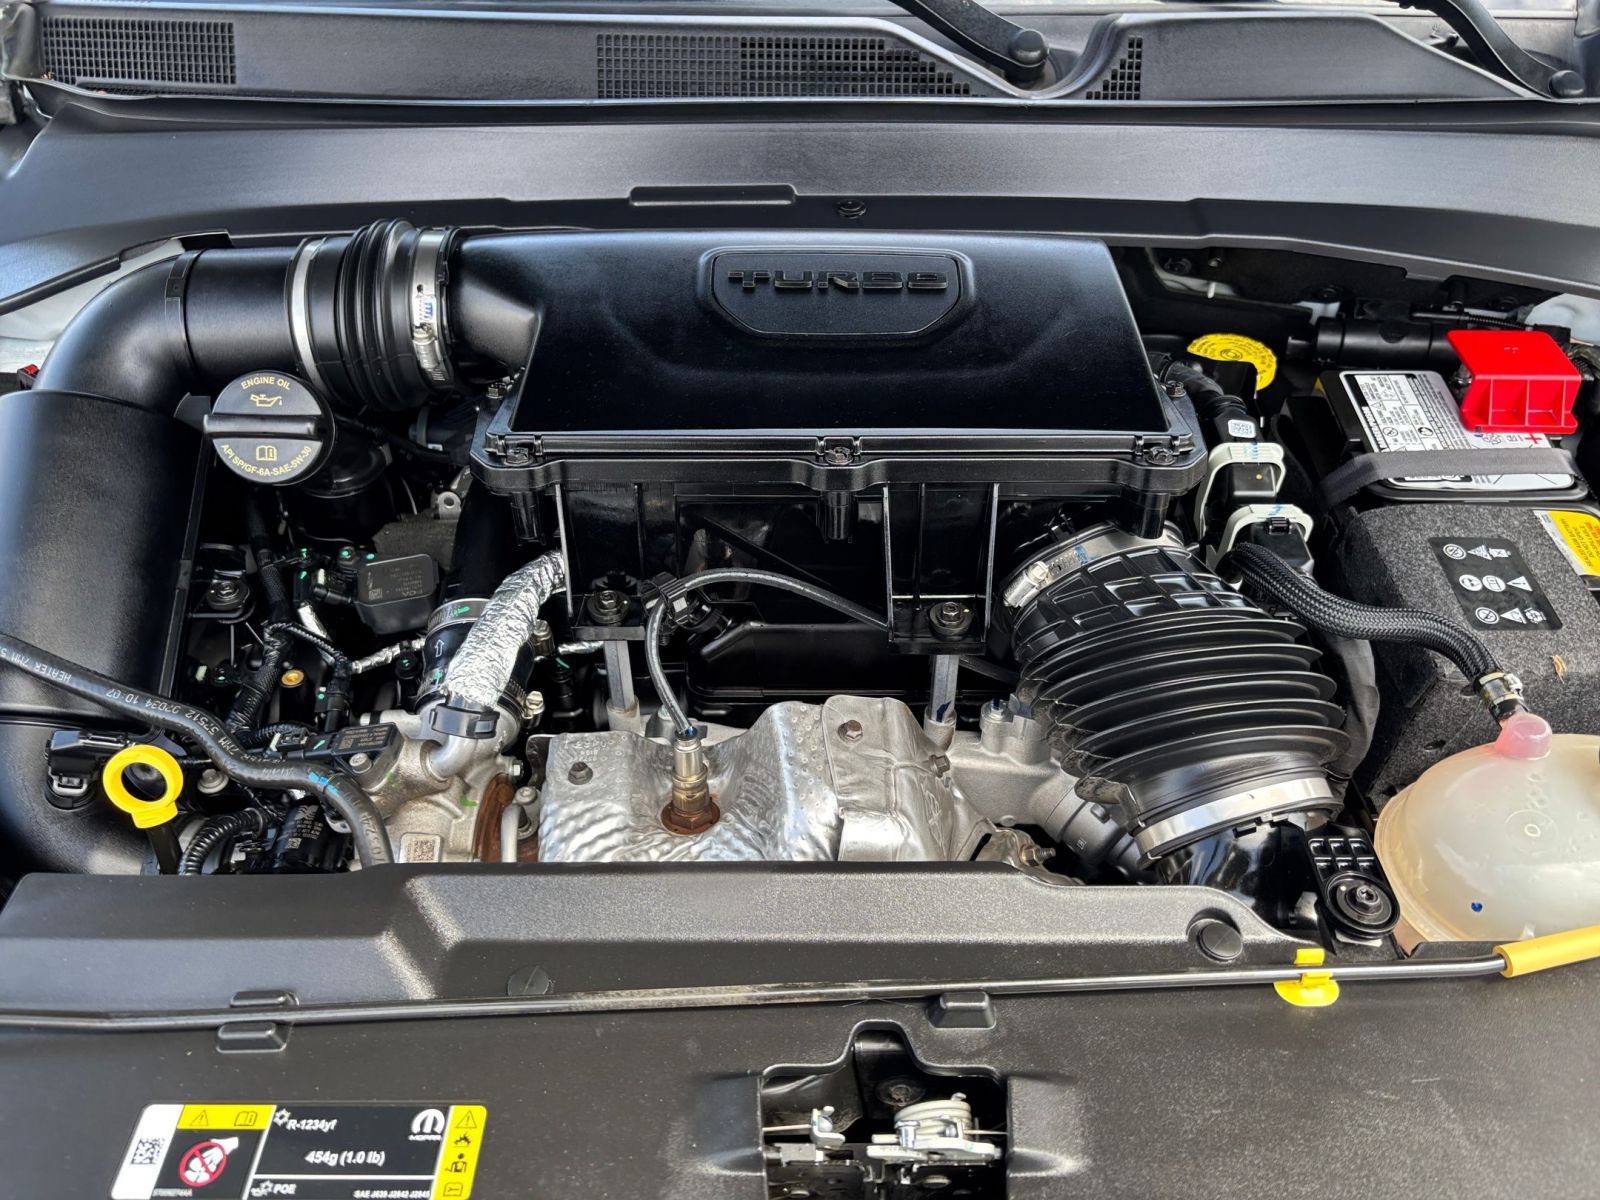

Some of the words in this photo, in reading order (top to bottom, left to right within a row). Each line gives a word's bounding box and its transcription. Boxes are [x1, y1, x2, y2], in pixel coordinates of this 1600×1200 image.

[727, 269, 949, 290] TURBO
[240, 376, 276, 390] ENGINE
[276, 378, 291, 391] OIL
[221, 443, 234, 459] API
[33, 661, 72, 684] HEATER
[286, 1118, 338, 1132] R-1234yf
[305, 1150, 338, 1166] 454g
[339, 1150, 365, 1166] (1.0
[366, 1150, 386, 1166] lb)
[273, 1183, 297, 1195] POE
